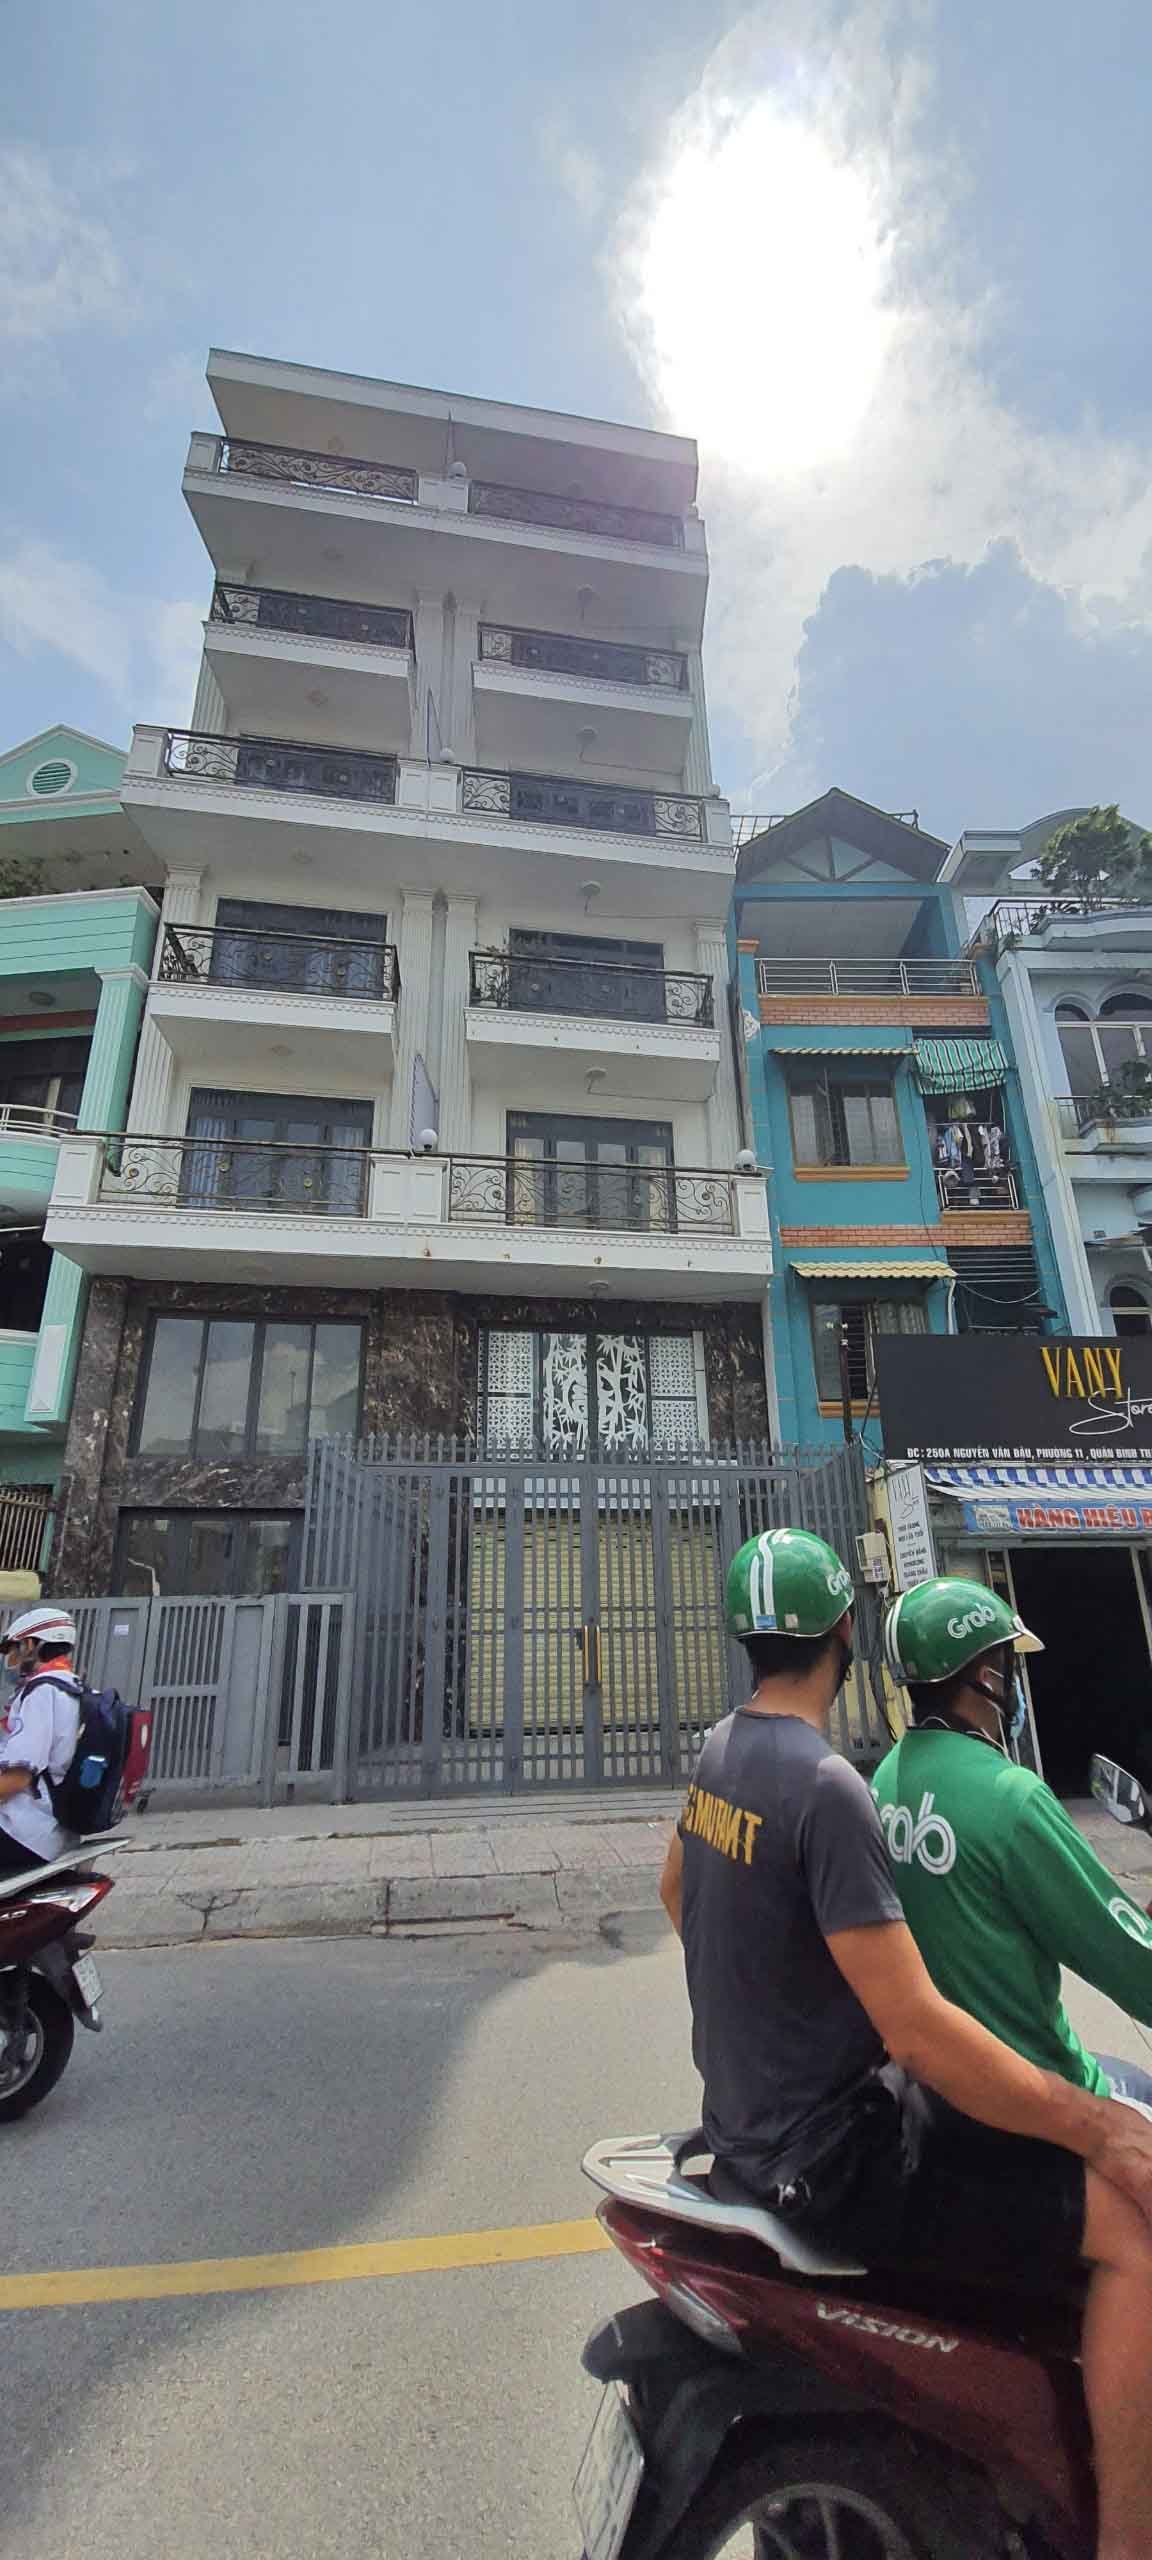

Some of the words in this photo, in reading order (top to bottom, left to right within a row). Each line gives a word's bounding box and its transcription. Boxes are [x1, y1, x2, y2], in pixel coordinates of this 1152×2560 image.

[1040, 1346, 1123, 1399] VANY
[1015, 1504, 1080, 1529] HÀNG
[947, 1602, 996, 1639] Grab
[816, 2301, 960, 2353] VISION
